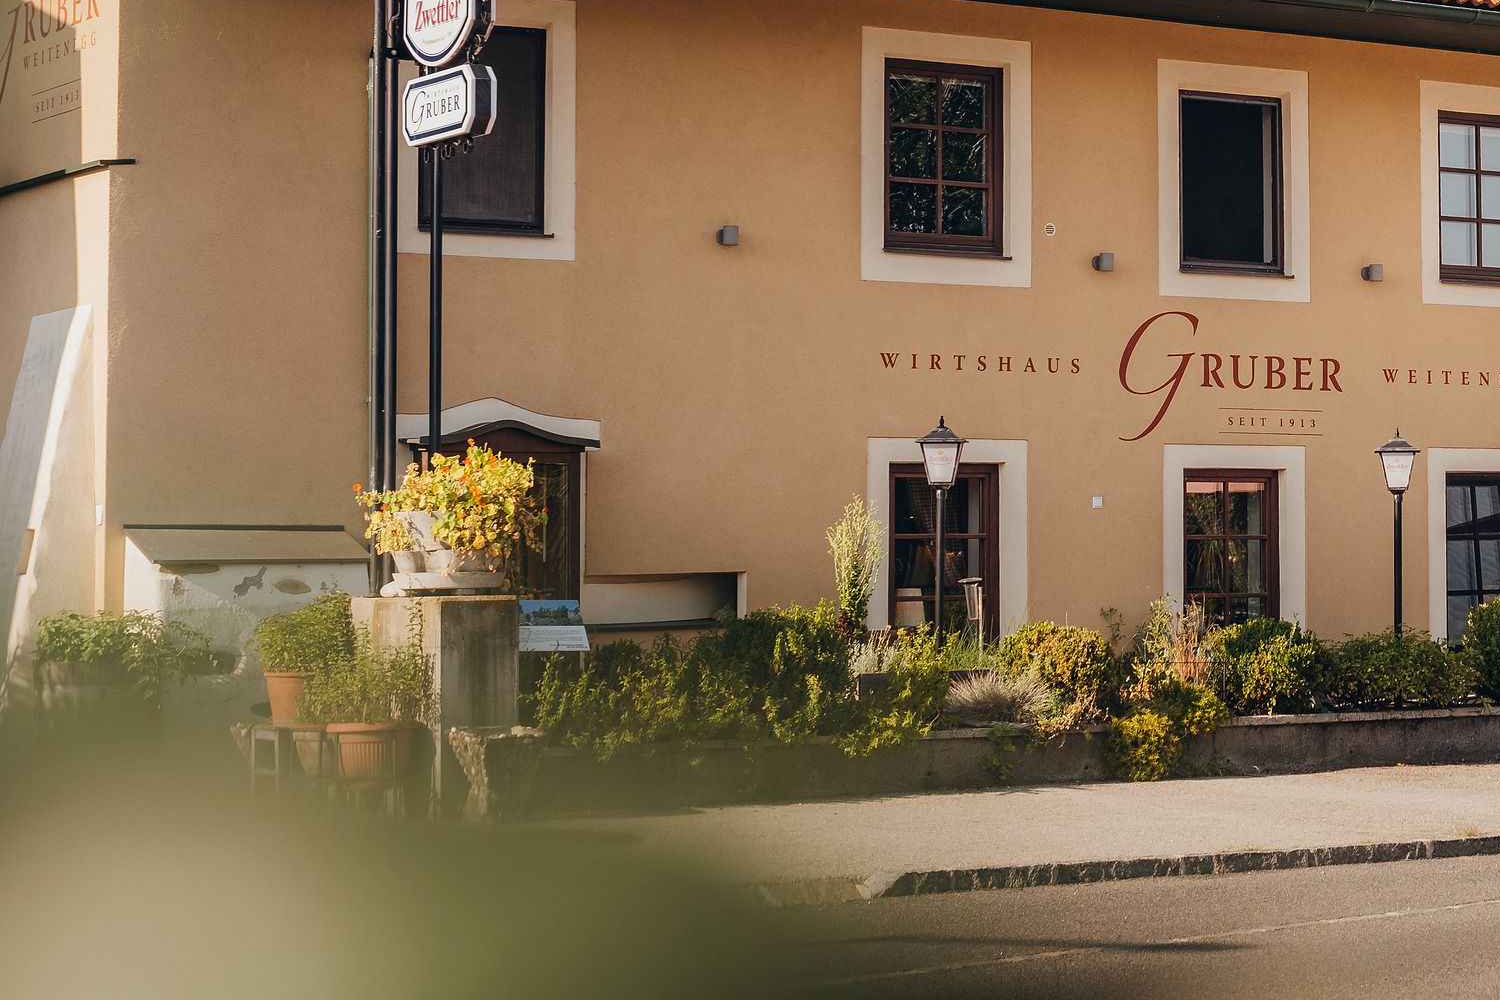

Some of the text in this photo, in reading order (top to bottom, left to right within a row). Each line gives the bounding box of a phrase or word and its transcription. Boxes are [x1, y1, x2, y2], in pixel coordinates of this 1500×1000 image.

[23, 30, 97, 71] WEITENEGG
[35, 89, 80, 113] SEIT 1913
[411, 91, 461, 132] GRUBER
[879, 352, 1081, 374] WIRTSHAUS
[1118, 310, 1344, 441] GRUBER
[1227, 416, 1317, 429] SEIT 1913
